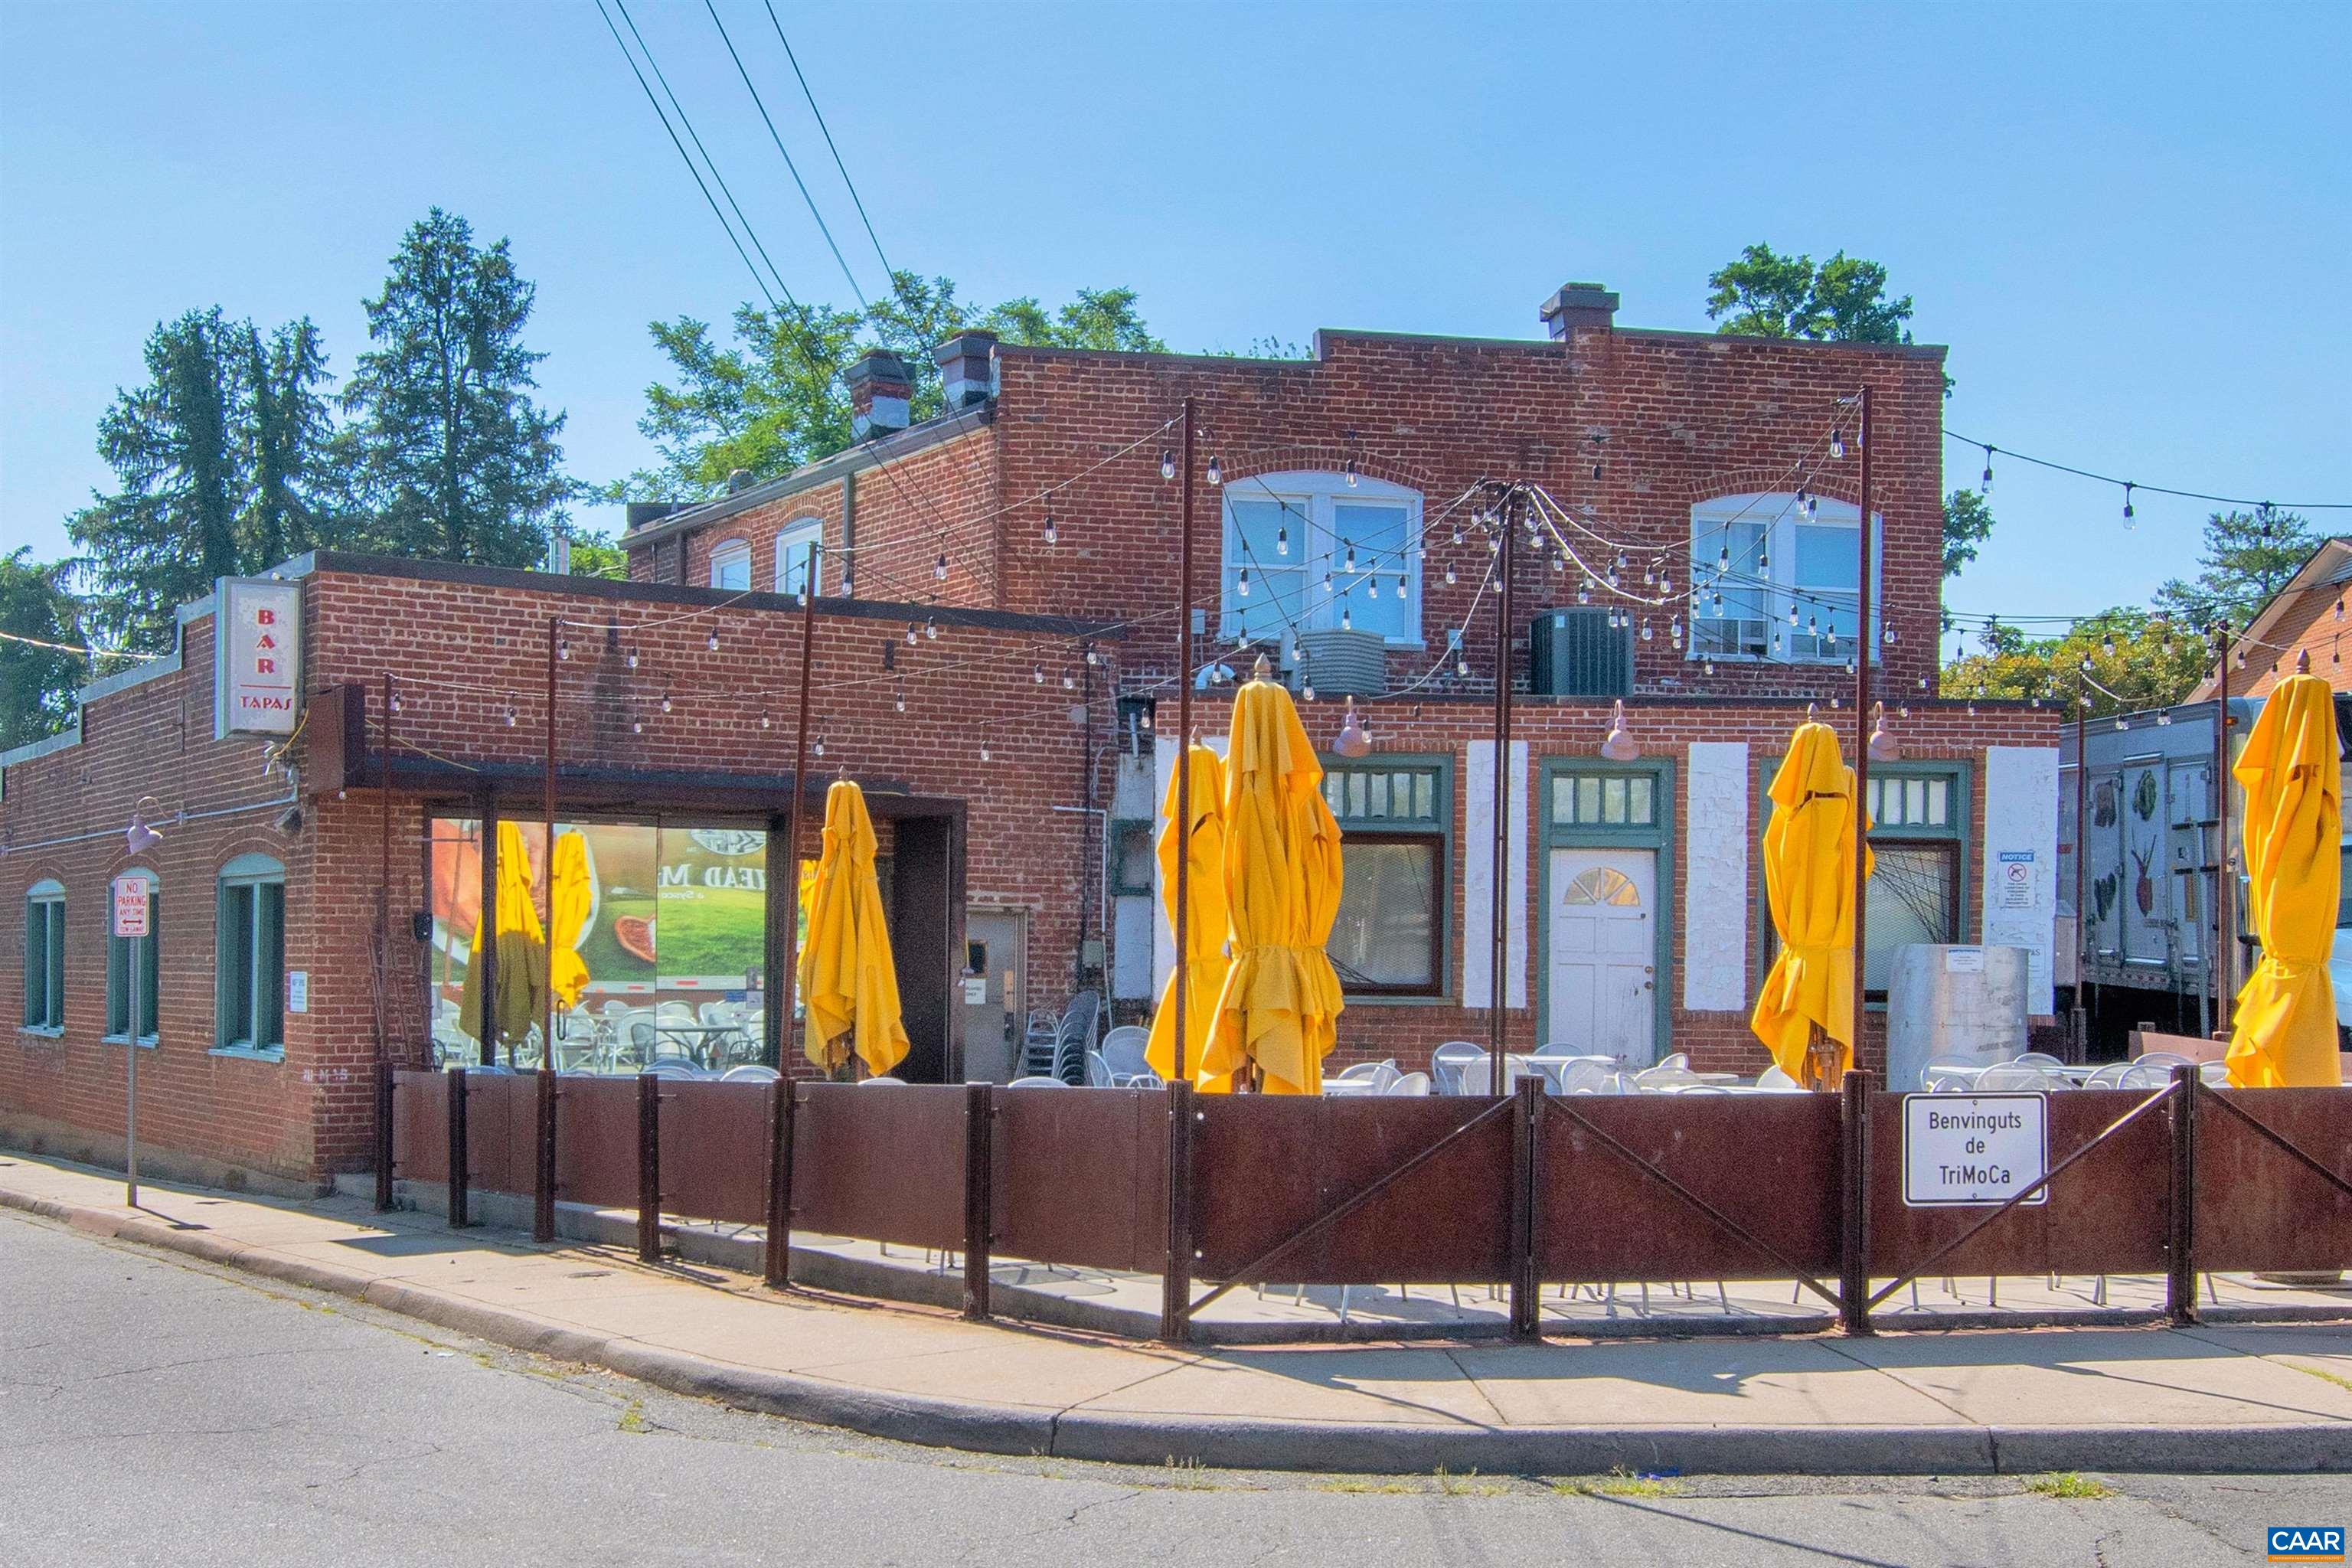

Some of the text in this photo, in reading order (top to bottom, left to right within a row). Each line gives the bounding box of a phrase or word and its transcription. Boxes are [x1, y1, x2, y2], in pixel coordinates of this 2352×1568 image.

[256, 609, 275, 674] BAR
[240, 696, 292, 710] TAPAS
[126, 882, 139, 893] NO
[117, 896, 146, 906] PARKING
[119, 907, 130, 916] ANY
[1929, 1112, 2022, 1134] Benvinguts
[1965, 1137, 1985, 1153] de
[1939, 1165, 2011, 1184] TriMoCa
